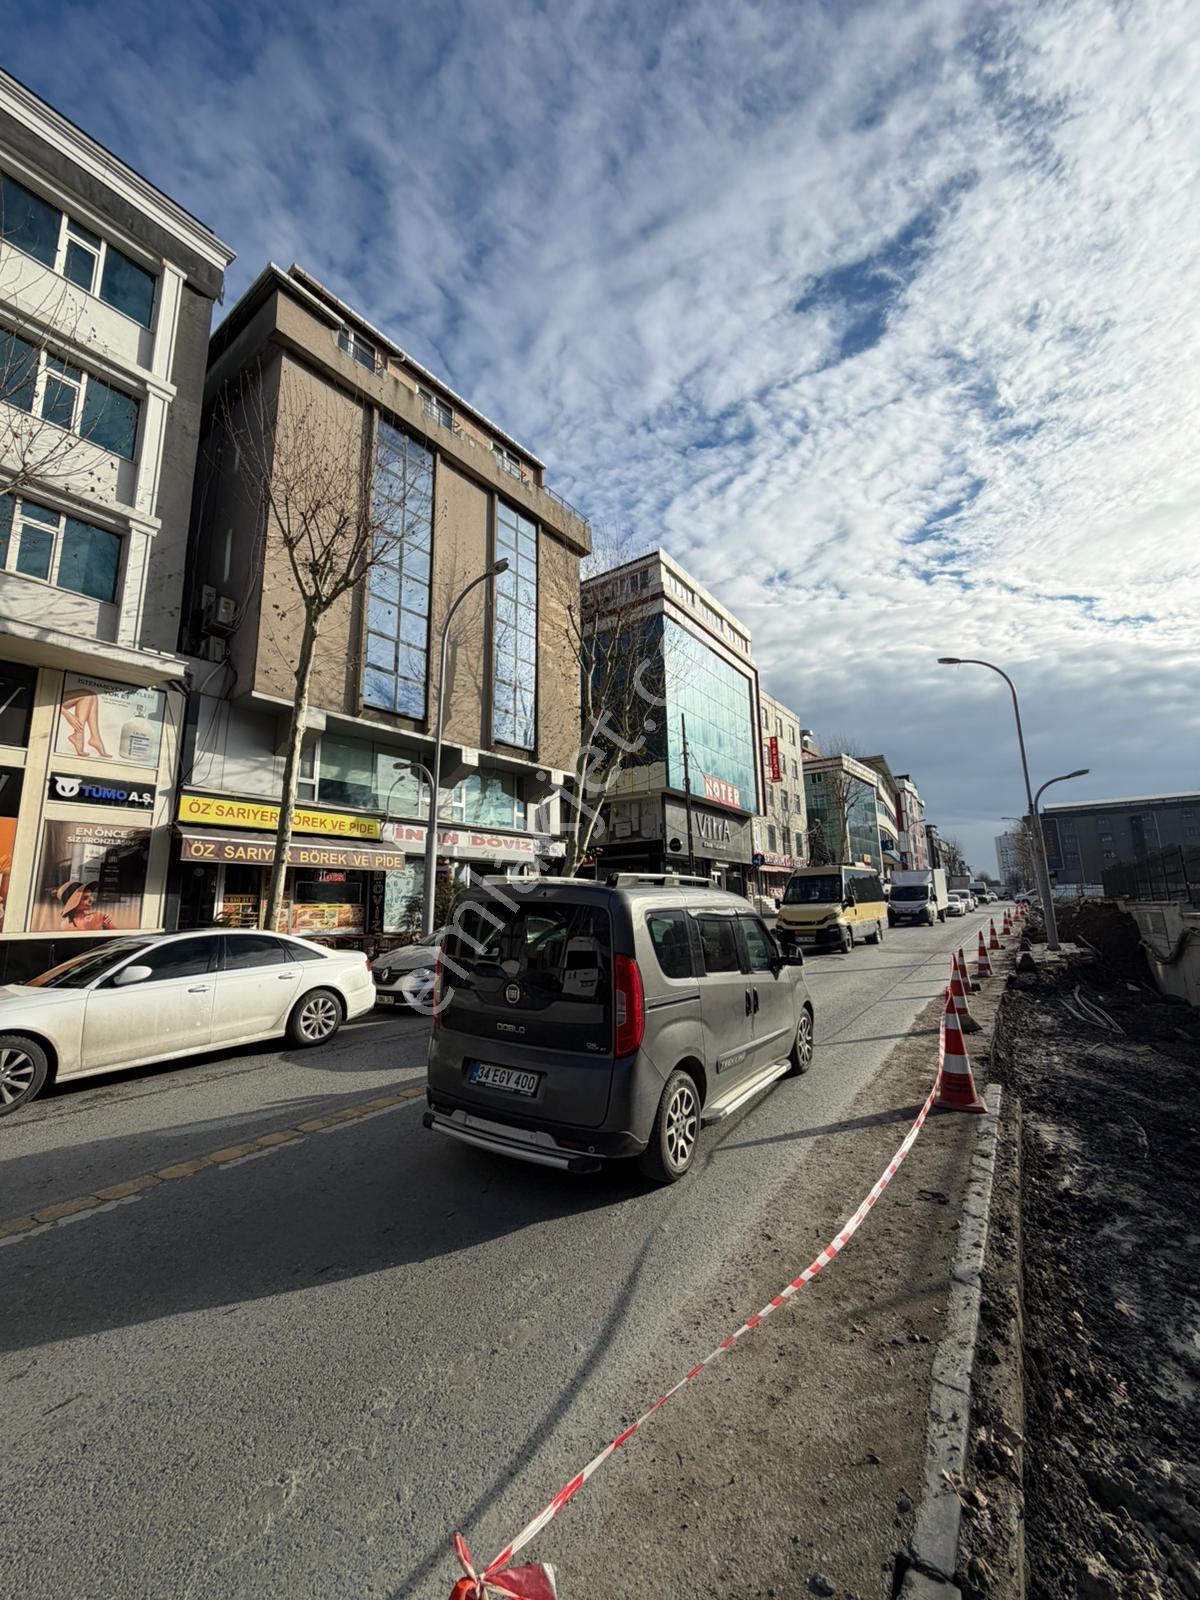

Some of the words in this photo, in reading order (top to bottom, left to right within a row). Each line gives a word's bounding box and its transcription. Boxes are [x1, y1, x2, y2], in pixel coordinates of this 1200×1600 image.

[705, 777, 740, 806] NOTER
[188, 799, 211, 816] ÖZ
[215, 804, 279, 823] SARIYER
[292, 812, 327, 829] ÖREK
[330, 820, 346, 831] VE
[349, 821, 375, 835] PİDE
[75, 827, 92, 836] EN
[94, 826, 128, 839] ÖNCE
[395, 825, 459, 845] İNN
[471, 833, 532, 851] DÖVİZ
[190, 841, 216, 858] ÖZ
[223, 845, 292, 863] SARIYR
[300, 850, 348, 866] BÖREK
[353, 855, 370, 867] VE
[375, 854, 401, 868] PİDE
[478, 1066, 491, 1080] 34
[514, 1073, 536, 1090] 400
